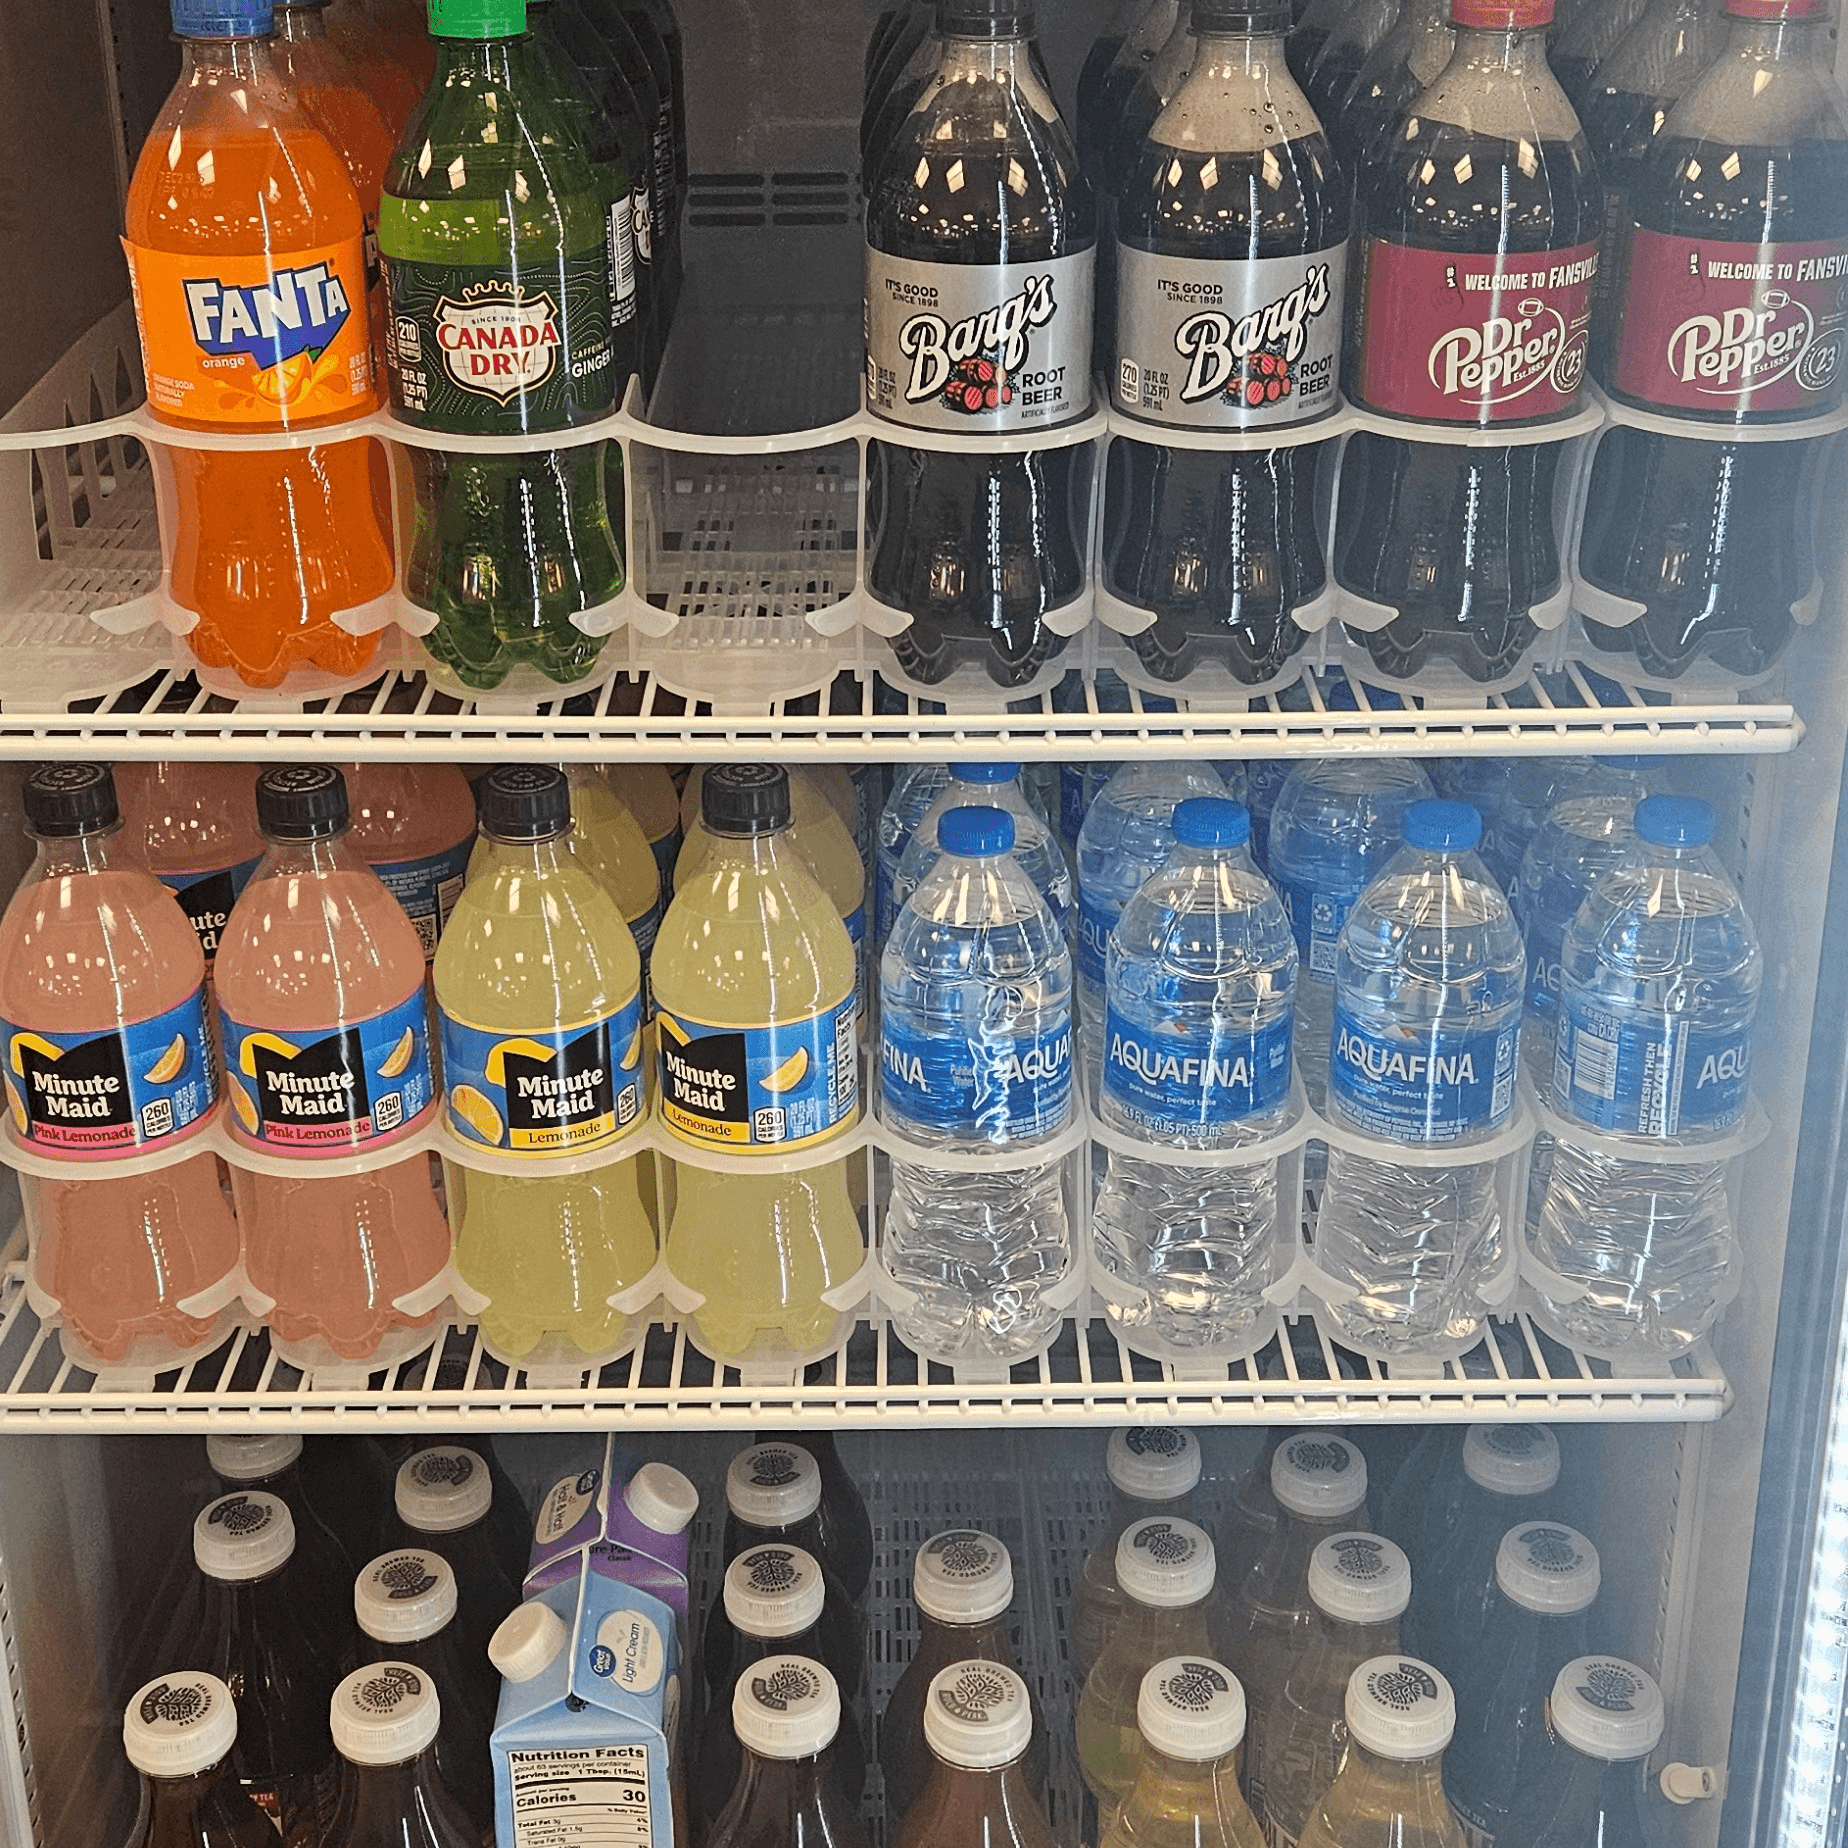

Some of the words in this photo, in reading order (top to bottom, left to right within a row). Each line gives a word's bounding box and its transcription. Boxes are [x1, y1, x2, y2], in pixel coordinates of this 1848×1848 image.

[1466, 273, 1527, 291] WELCOME
[1531, 272, 1546, 288] TO
[1708, 261, 1773, 280] WELCOME
[1778, 264, 1793, 279] TO
[904, 283, 939, 298] GOOD
[1158, 279, 1179, 292] IT'S
[1183, 283, 1223, 295] GOOD
[1167, 292, 1196, 303] SINCE
[1199, 295, 1223, 304] 1898
[185, 264, 349, 343] FANTA
[892, 292, 915, 305] SINCE
[917, 298, 938, 307] 1898
[399, 322, 416, 341] 210
[471, 316, 498, 325] SINCE
[1721, 307, 1777, 348] Dr
[438, 323, 559, 350] CANADA
[899, 274, 1057, 404] Barq's
[1175, 263, 1330, 404] Barq's
[1482, 317, 1532, 360] Dr
[1428, 327, 1558, 395] Pepper
[1668, 315, 1805, 385] Pepper
[1816, 346, 1836, 373] 23
[202, 357, 245, 368] orange
[471, 351, 529, 376] DRY
[1123, 363, 1137, 383] 270
[1301, 355, 1333, 377] ROOT
[1022, 367, 1066, 387] ROOT
[1300, 374, 1330, 396] BEER
[1022, 387, 1062, 406] BEER
[1110, 1032, 1249, 1088] AQUAFINA
[1337, 1027, 1476, 1085] AQUAFINA
[666, 1051, 736, 1090] Minute
[32, 1071, 120, 1096] Minute
[265, 1070, 355, 1094] Minute
[517, 1068, 604, 1097] Minute
[1638, 1079, 1652, 1134] REFRESH
[1645, 1042, 1657, 1077] THEN
[279, 1093, 346, 1116] Maid
[378, 1095, 399, 1115] 260
[531, 1090, 595, 1119] Maid
[673, 1078, 725, 1111] Maid
[1167, 1097, 1196, 1105] perfect
[1392, 1089, 1421, 1099] perfect
[45, 1096, 110, 1118] Maid
[146, 1102, 169, 1121] 260
[672, 1108, 732, 1136] Lemonade
[758, 1111, 782, 1126] 260
[34, 1124, 60, 1141] Pink
[62, 1126, 135, 1142] Lemonade
[266, 1124, 294, 1139] Pink
[296, 1121, 370, 1140] Lemonade
[529, 1122, 601, 1144] Lemonade
[626, 1622, 641, 1658] Cream
[623, 1659, 638, 1683] Light
[511, 1751, 590, 1763] Nutrition
[596, 1747, 645, 1758] Facts
[516, 1792, 577, 1808] Calories
[622, 1789, 646, 1803] 30
